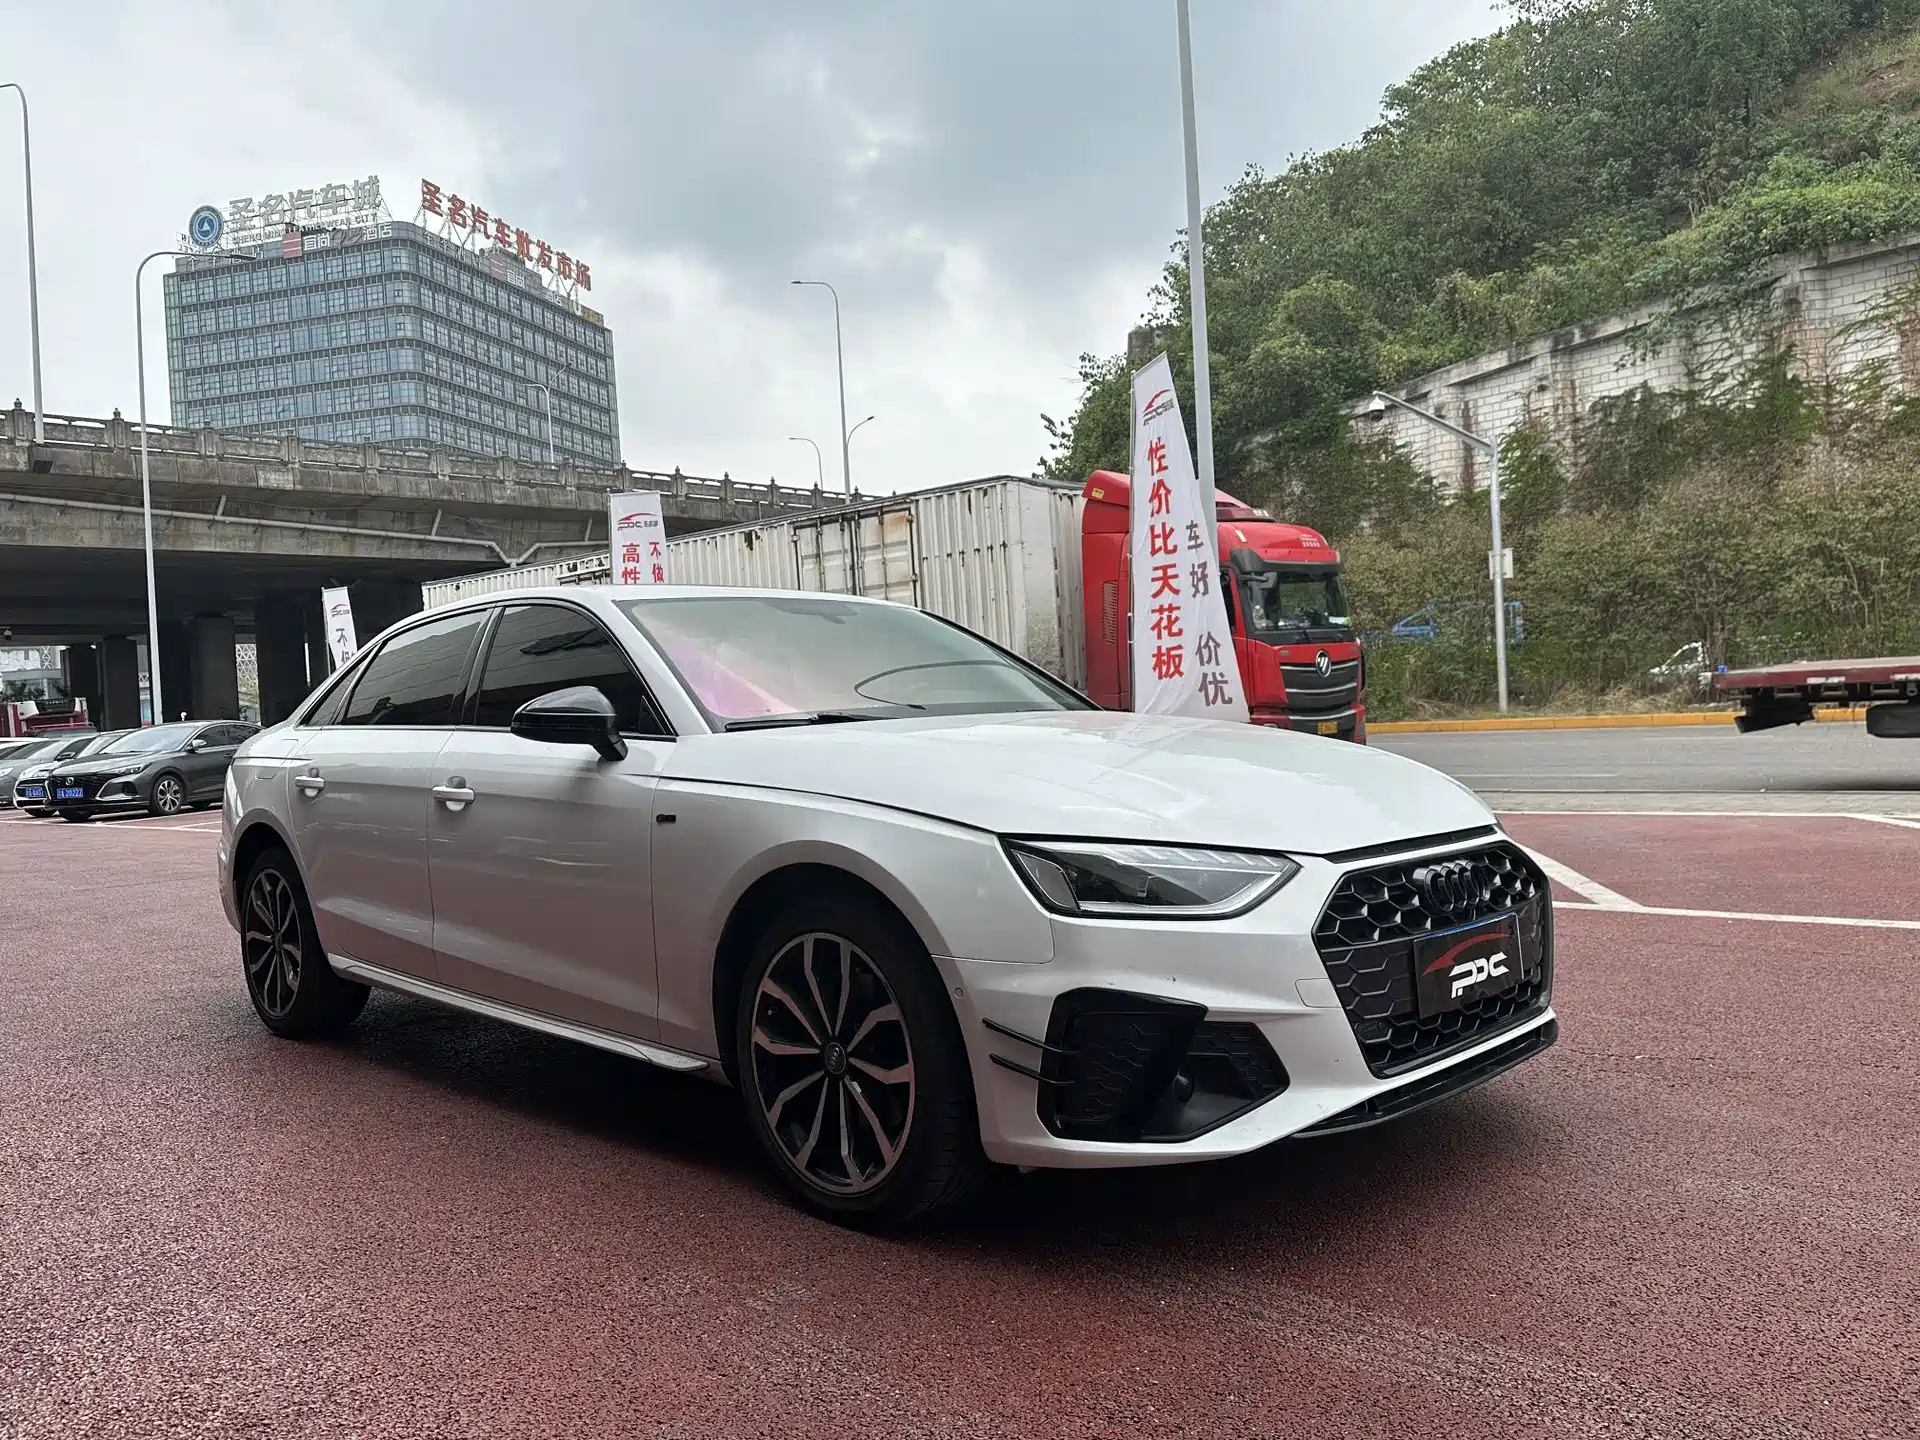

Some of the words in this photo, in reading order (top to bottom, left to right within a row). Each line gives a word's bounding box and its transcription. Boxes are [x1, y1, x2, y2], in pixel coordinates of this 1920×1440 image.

[229, 174, 382, 233] 圣名汽车城
[355, 211, 377, 224] CITY
[421, 178, 592, 292] 圣名汽车批发市场
[621, 542, 641, 585] 高性
[648, 541, 665, 584] 不做
[1147, 435, 1185, 681] 性价比天花板
[1185, 519, 1210, 600] 车好
[1194, 631, 1233, 707] 价优
